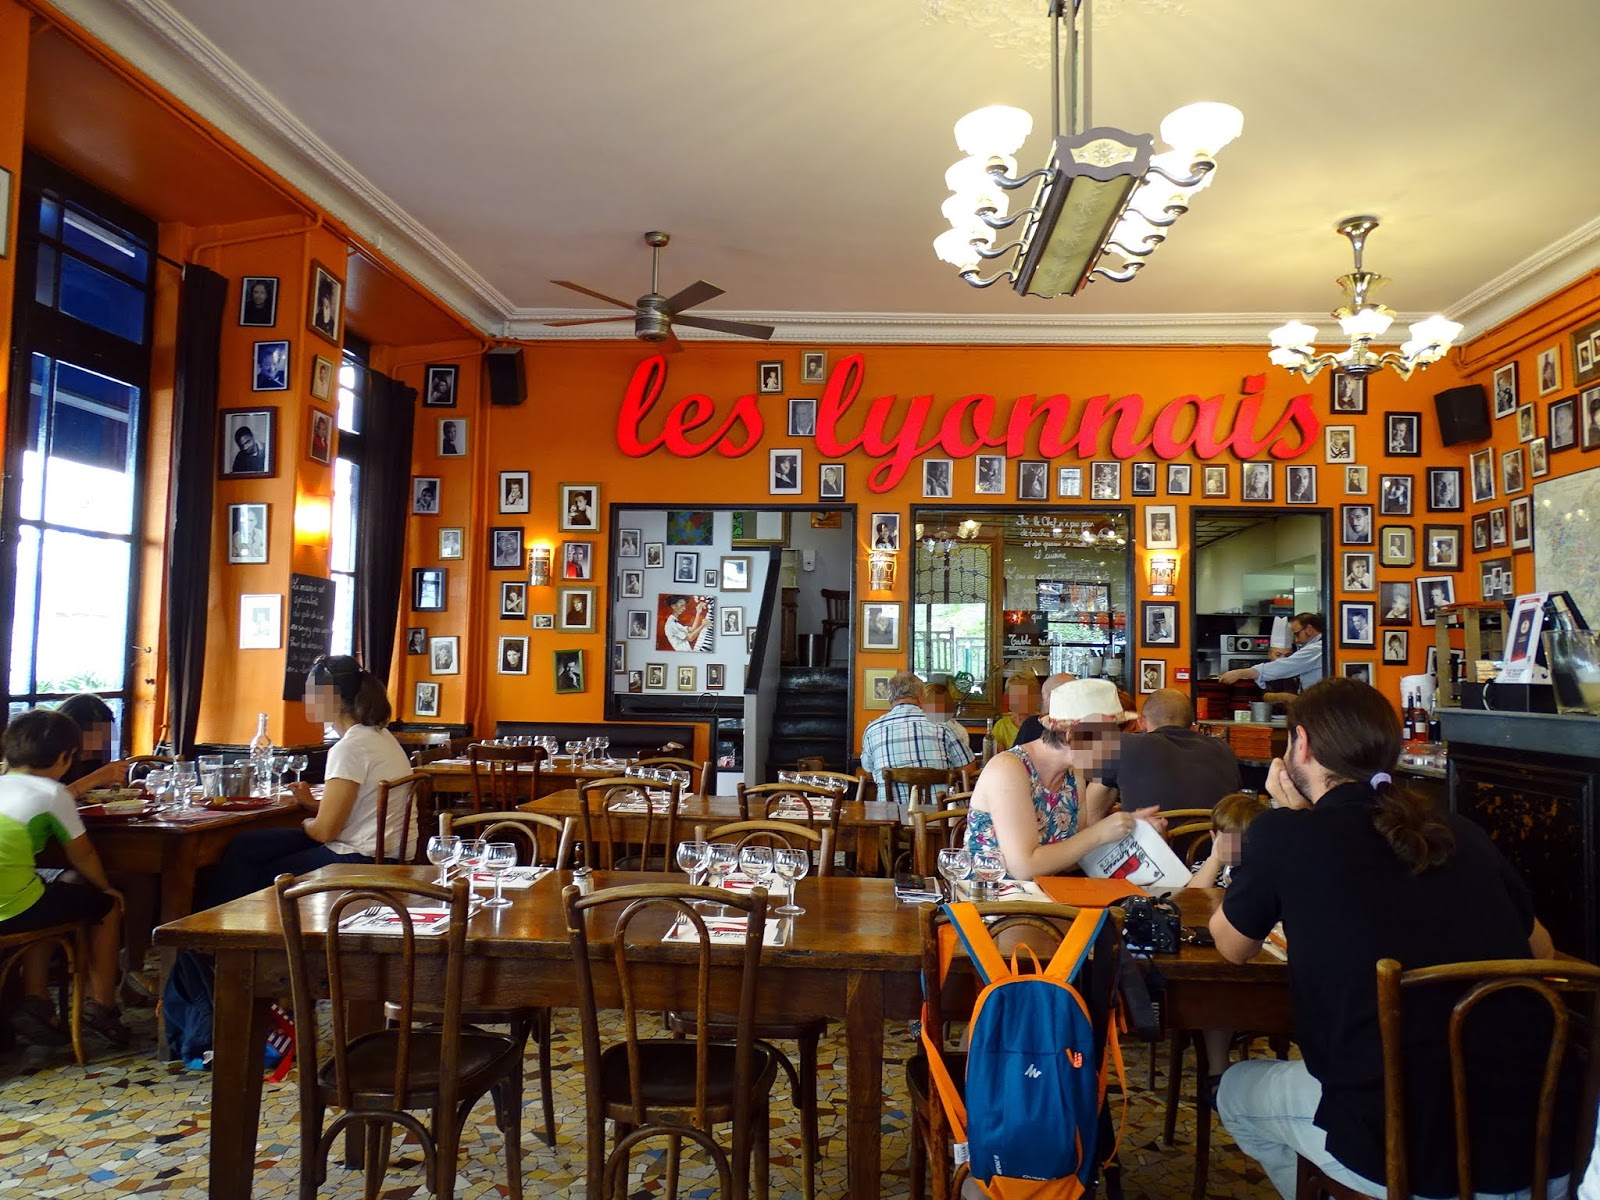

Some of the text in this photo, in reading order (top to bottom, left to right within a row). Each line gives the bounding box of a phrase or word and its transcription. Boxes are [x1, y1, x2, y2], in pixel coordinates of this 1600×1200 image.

[617, 353, 1321, 493] les lyonnais
[1033, 549, 1067, 560] il cuisine
[1008, 633, 1032, 646] Table
